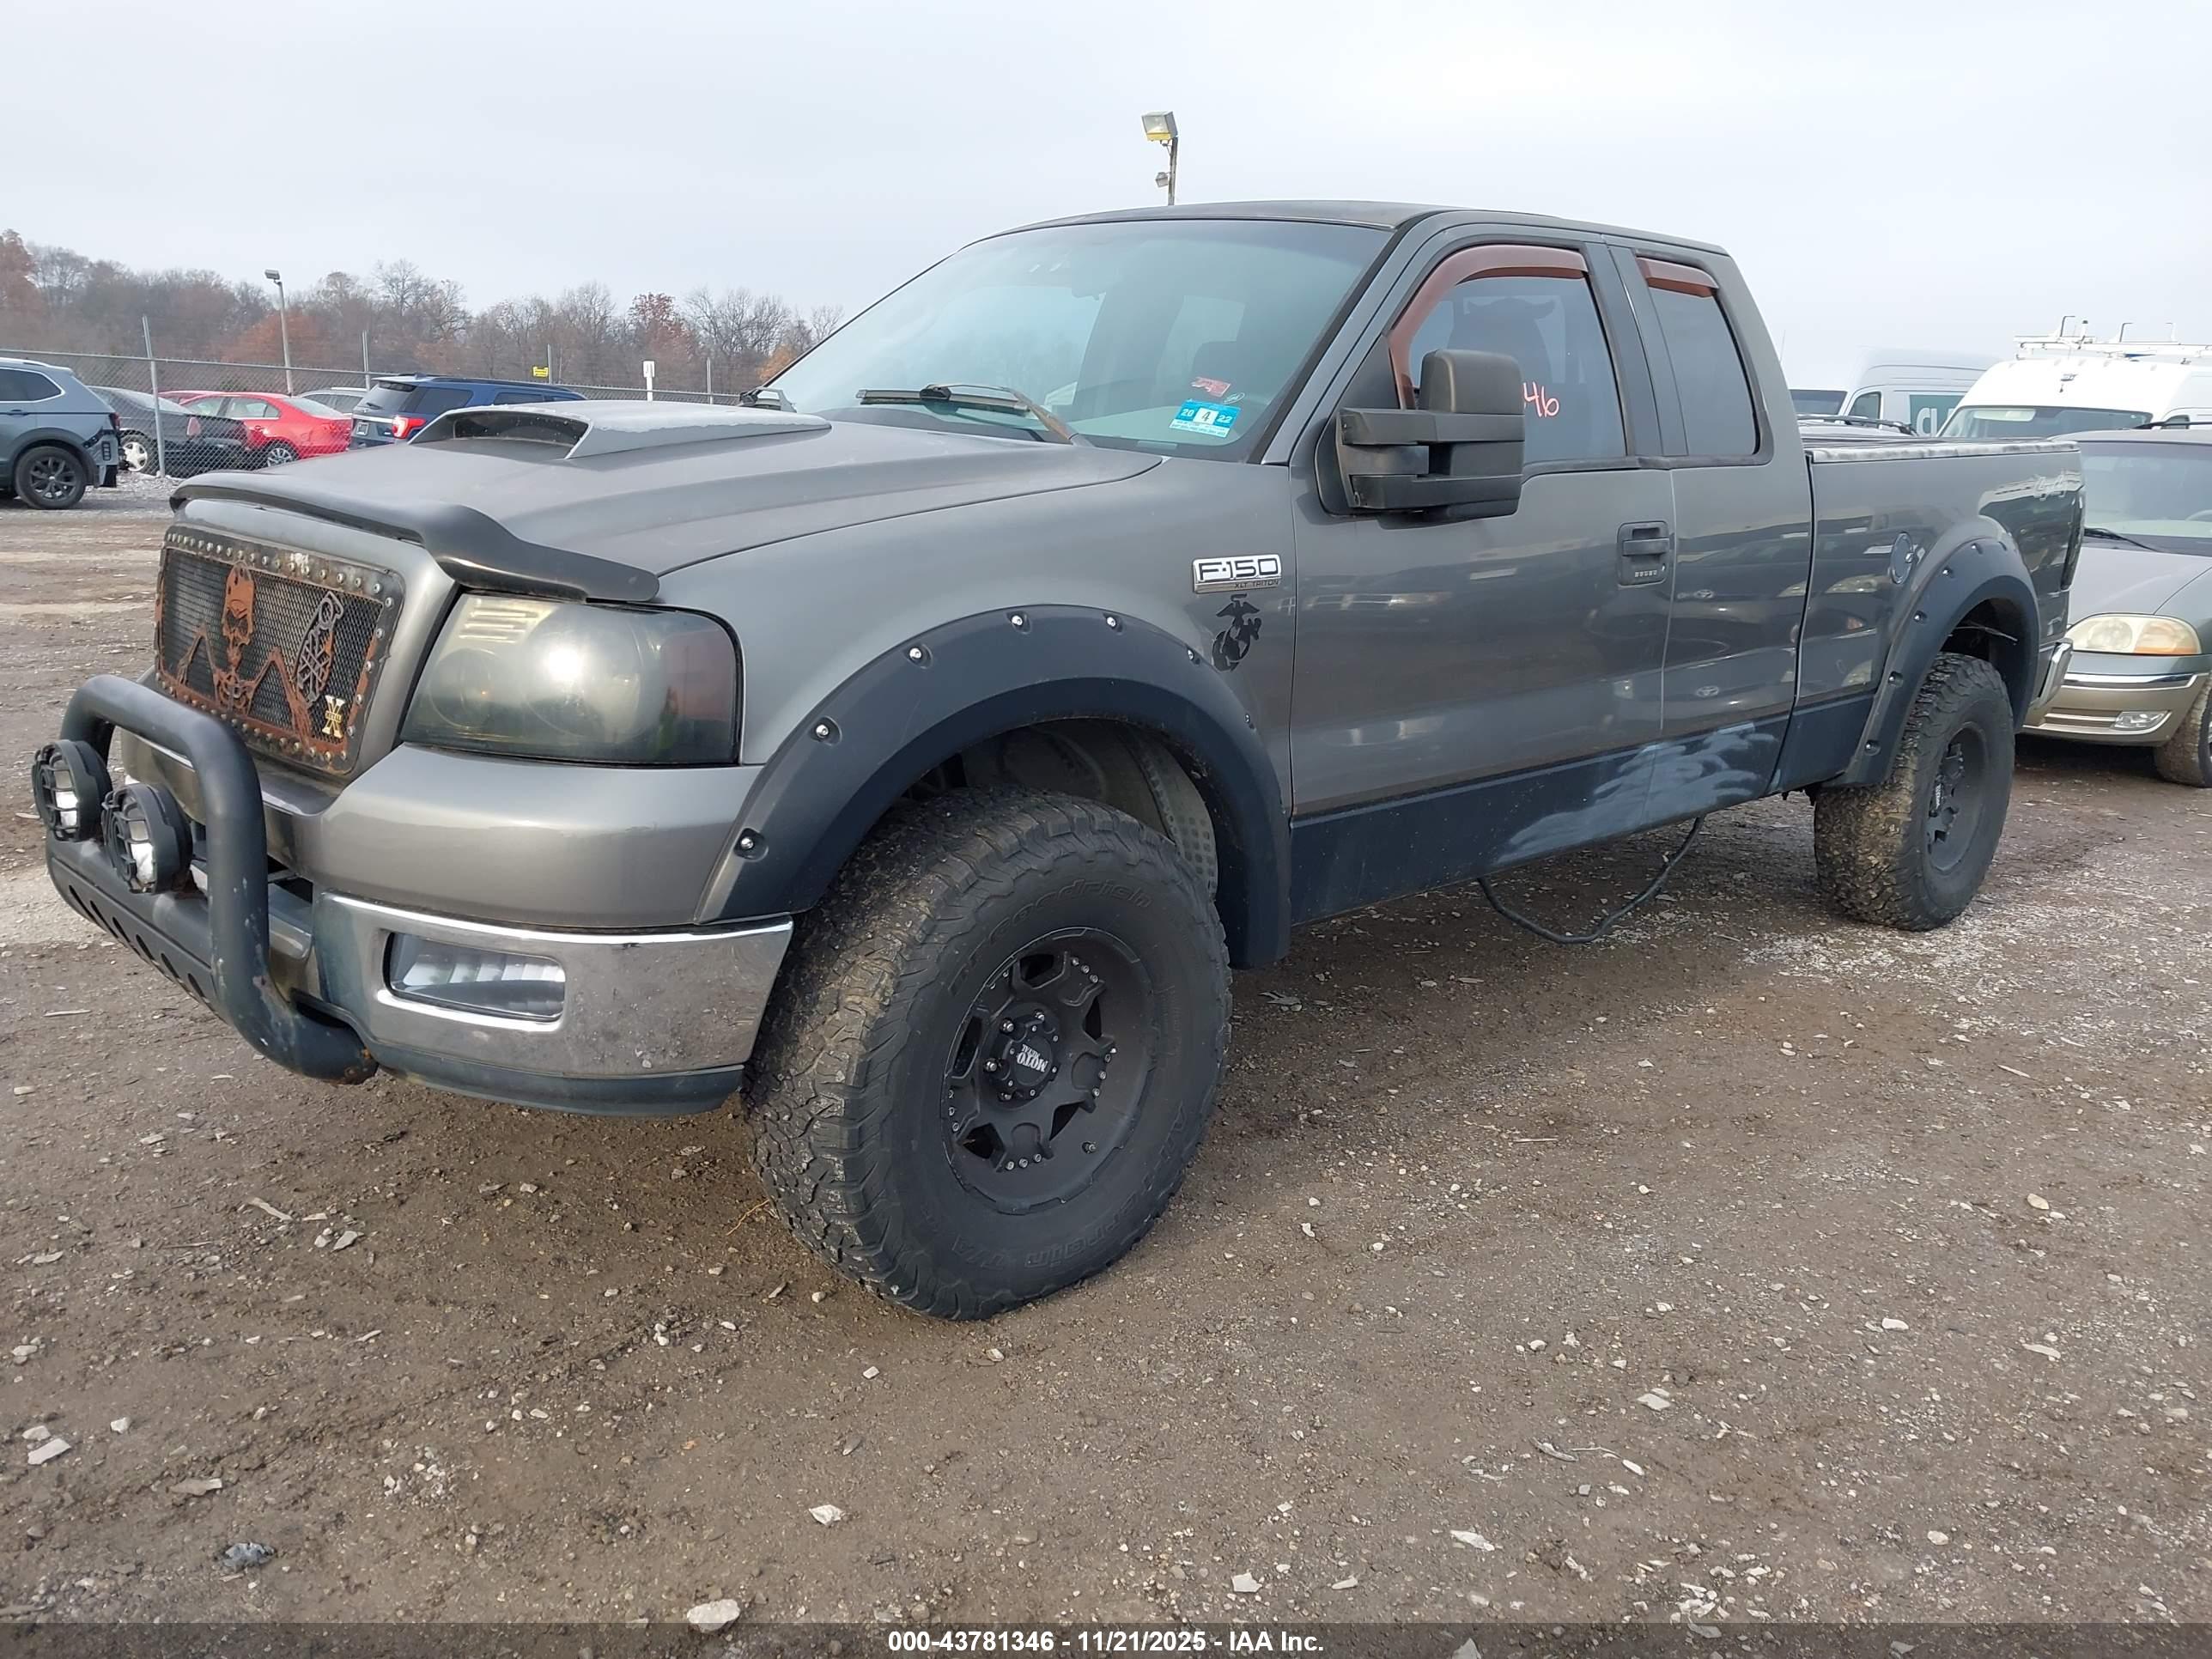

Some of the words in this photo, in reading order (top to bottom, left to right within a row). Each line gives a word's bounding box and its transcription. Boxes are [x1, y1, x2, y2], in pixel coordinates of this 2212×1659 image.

[1523, 381, 1559, 418] 46
[1180, 408, 1195, 417] 20
[1201, 411, 1212, 422] 4
[1217, 414, 1233, 423] 22
[1252, 578, 1279, 587] TRITON
[1016, 1051, 1048, 1073] MOTO
